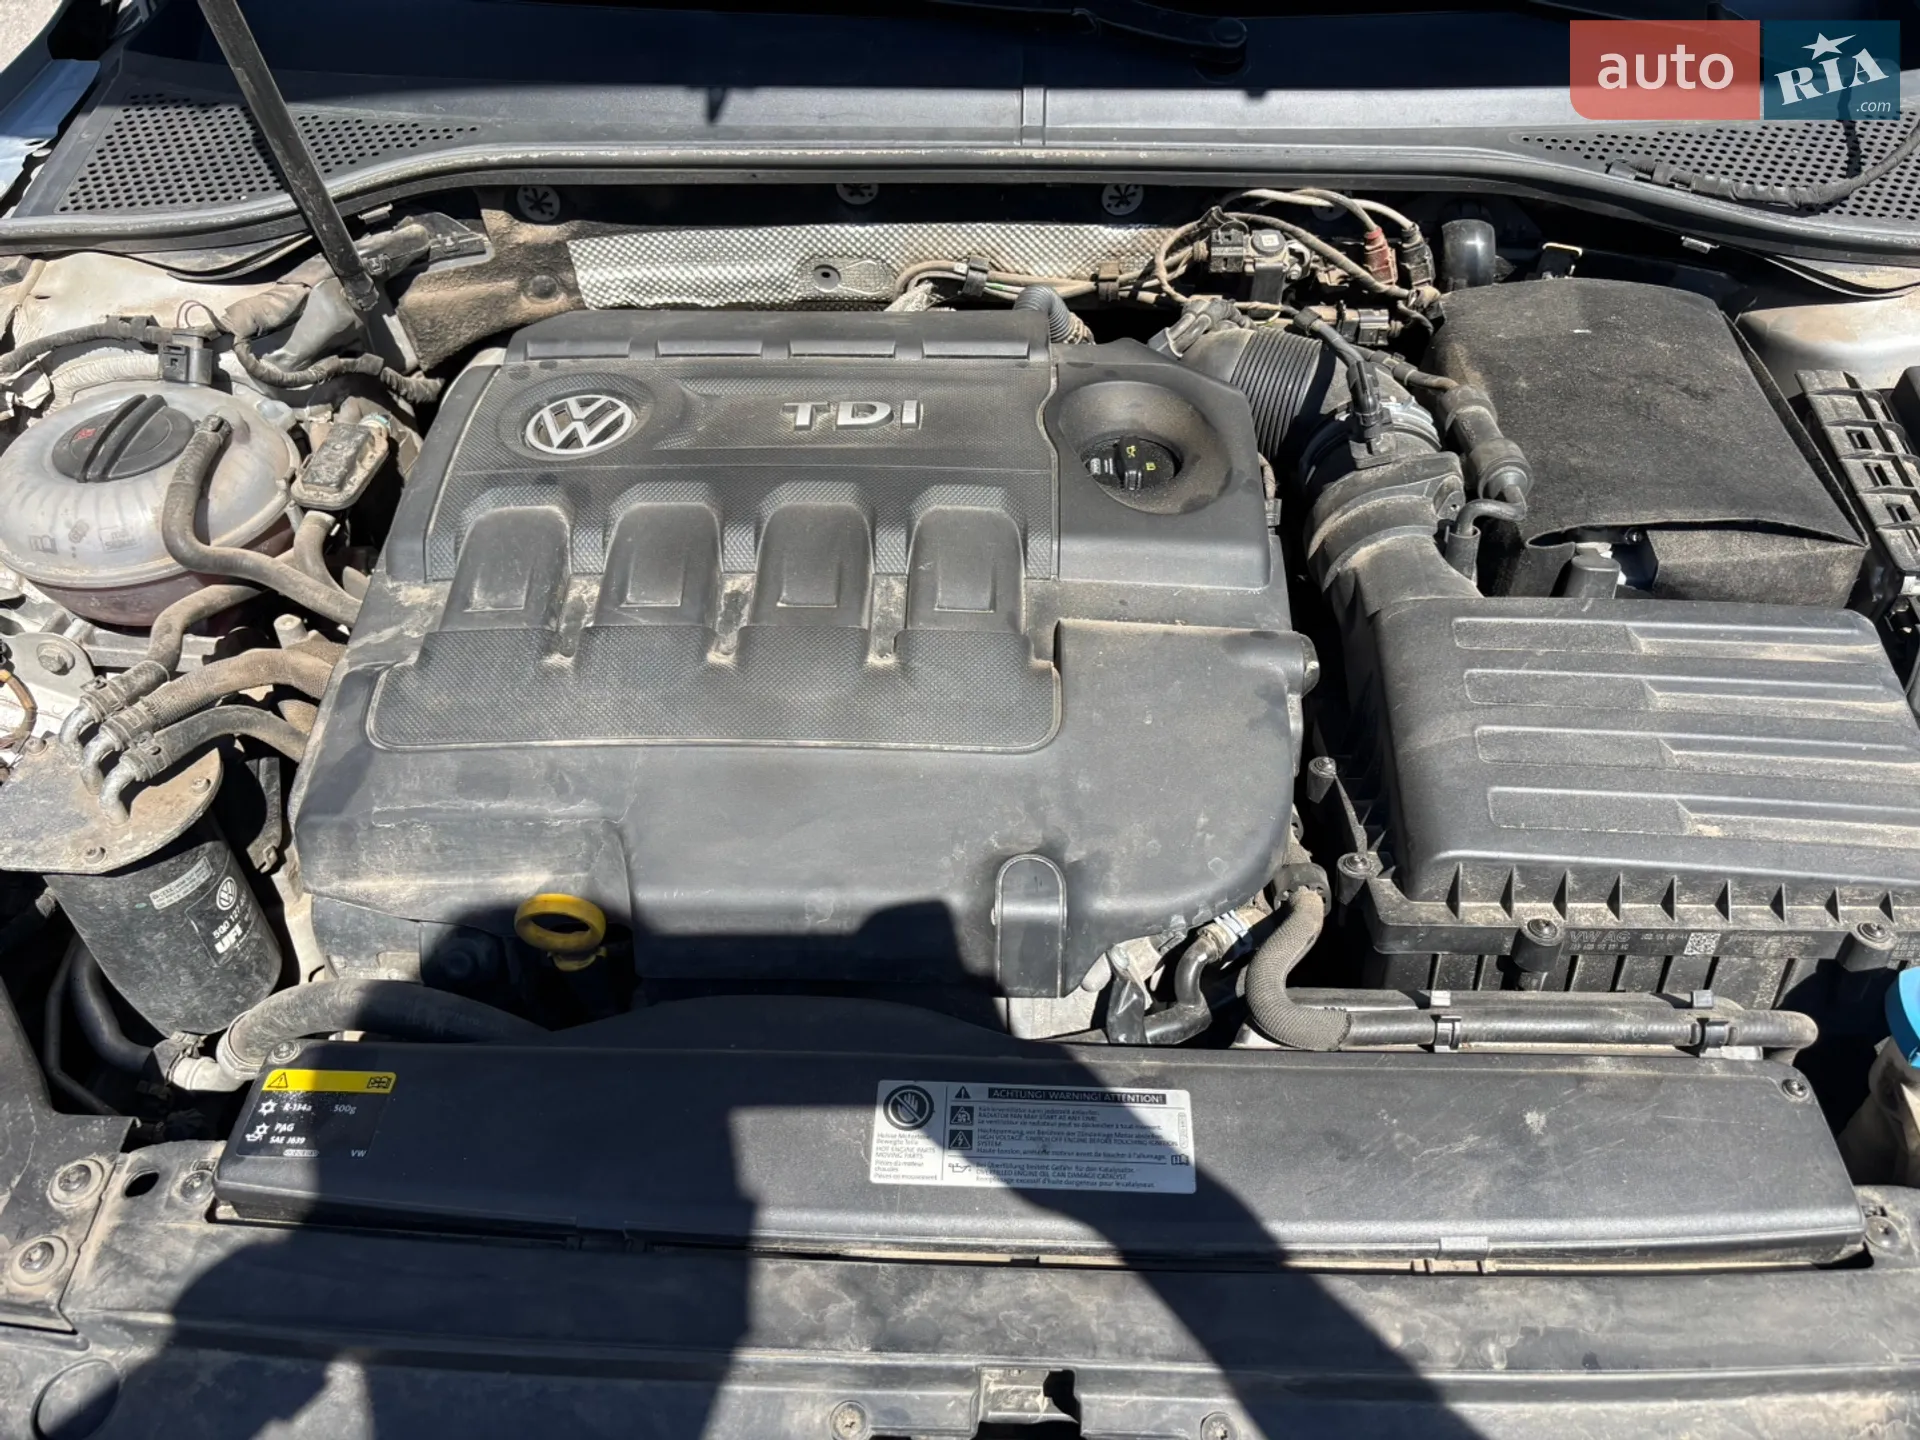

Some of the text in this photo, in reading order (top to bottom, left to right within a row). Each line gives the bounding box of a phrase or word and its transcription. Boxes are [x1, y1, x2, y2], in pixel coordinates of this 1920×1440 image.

[781, 400, 924, 432] TDI
[214, 922, 243, 954] UFI
[1569, 930, 1600, 943] VW
[1601, 930, 1631, 943] AG
[992, 1089, 1163, 1104] ACHTUNG! WARNING! ATTENTION!
[333, 1104, 357, 1114] 500g
[274, 1122, 295, 1133] PAG
[269, 1136, 285, 1144] SAE
[350, 1149, 367, 1157] VW
